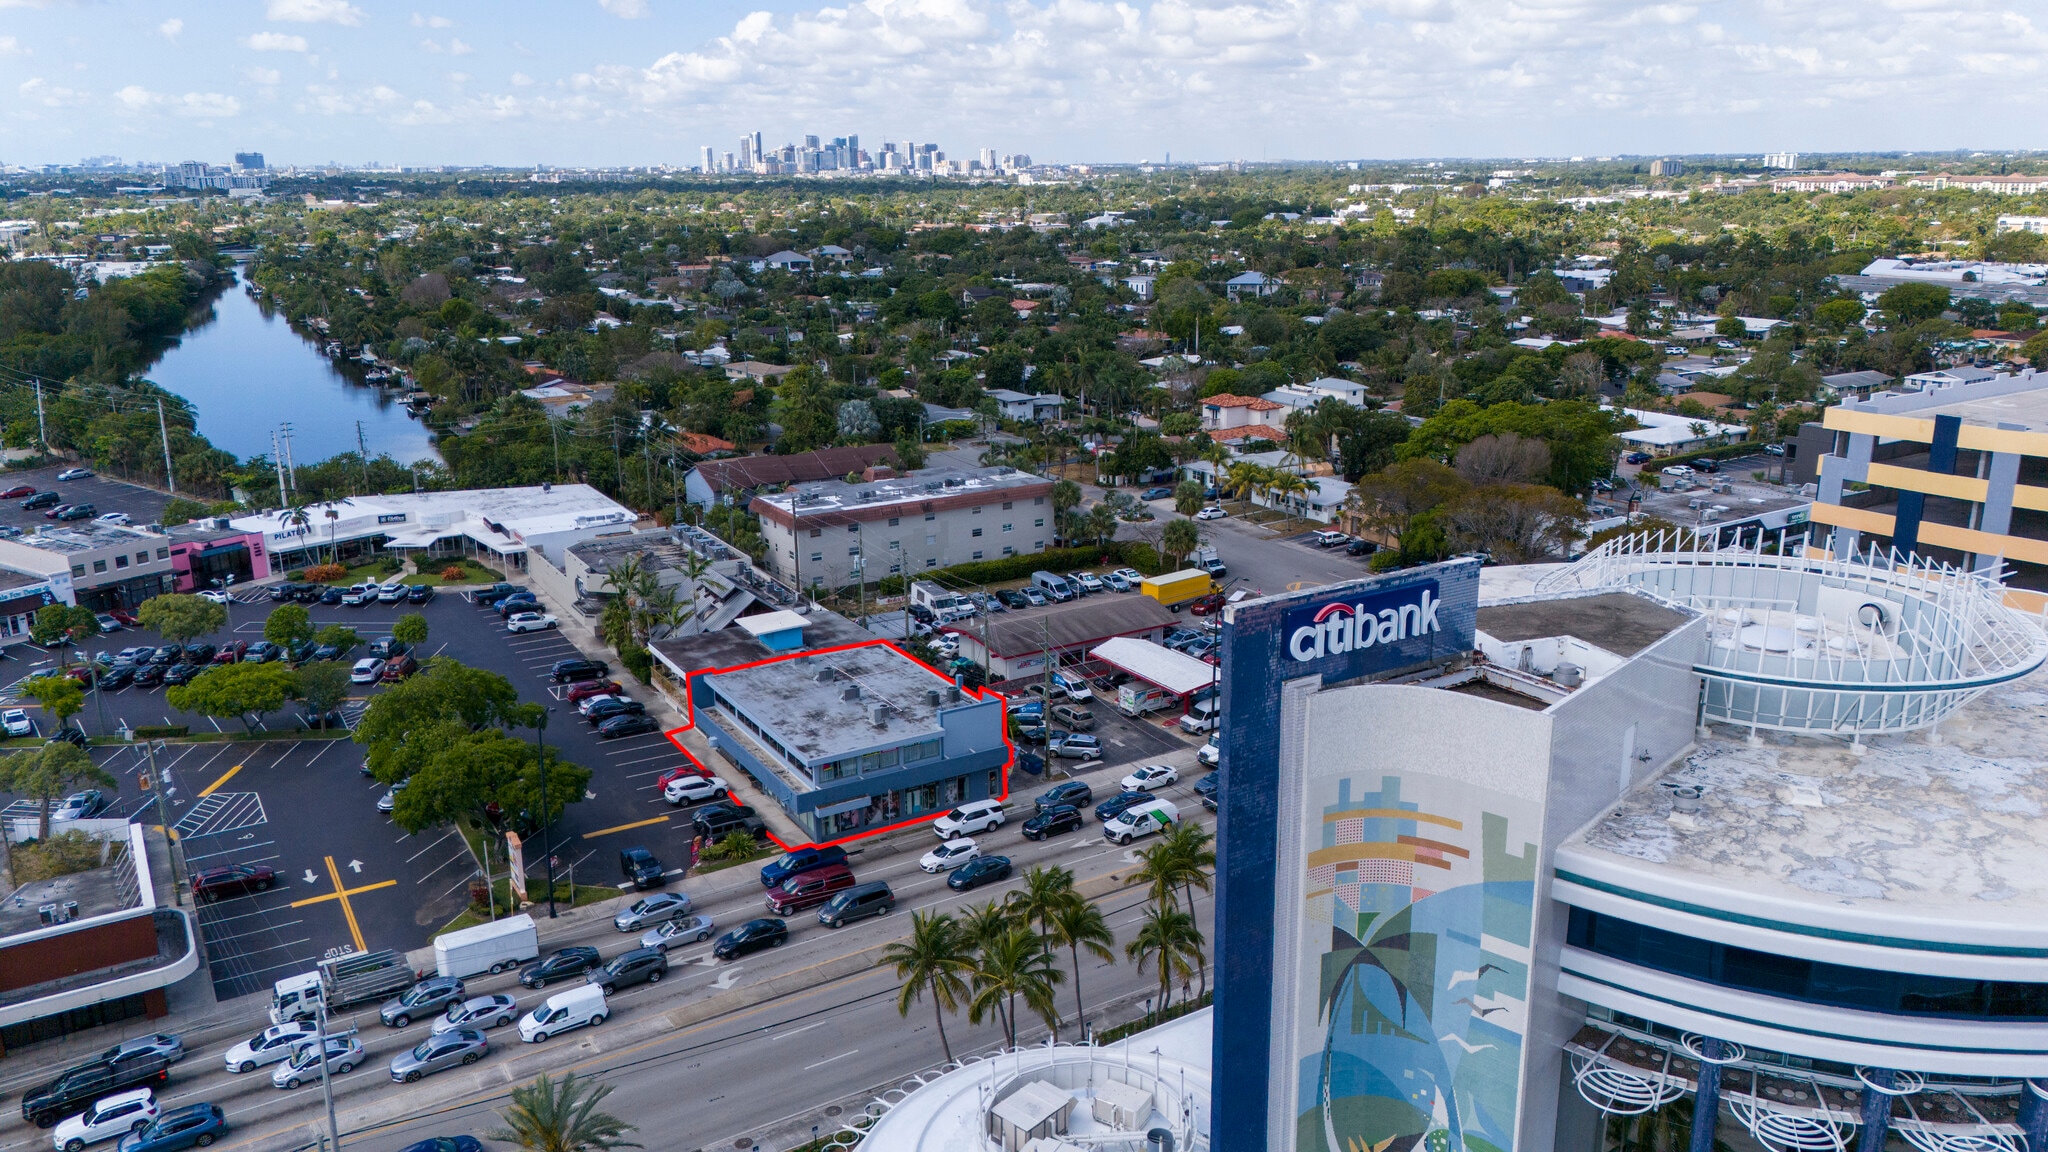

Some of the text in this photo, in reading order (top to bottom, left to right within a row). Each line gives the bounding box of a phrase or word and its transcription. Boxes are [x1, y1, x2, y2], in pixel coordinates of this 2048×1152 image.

[274, 529, 306, 541] PILATES
[10, 591, 21, 599] For
[23, 587, 42, 595] Dogs
[1290, 589, 1441, 662] citibank
[324, 944, 353, 959] STOP
